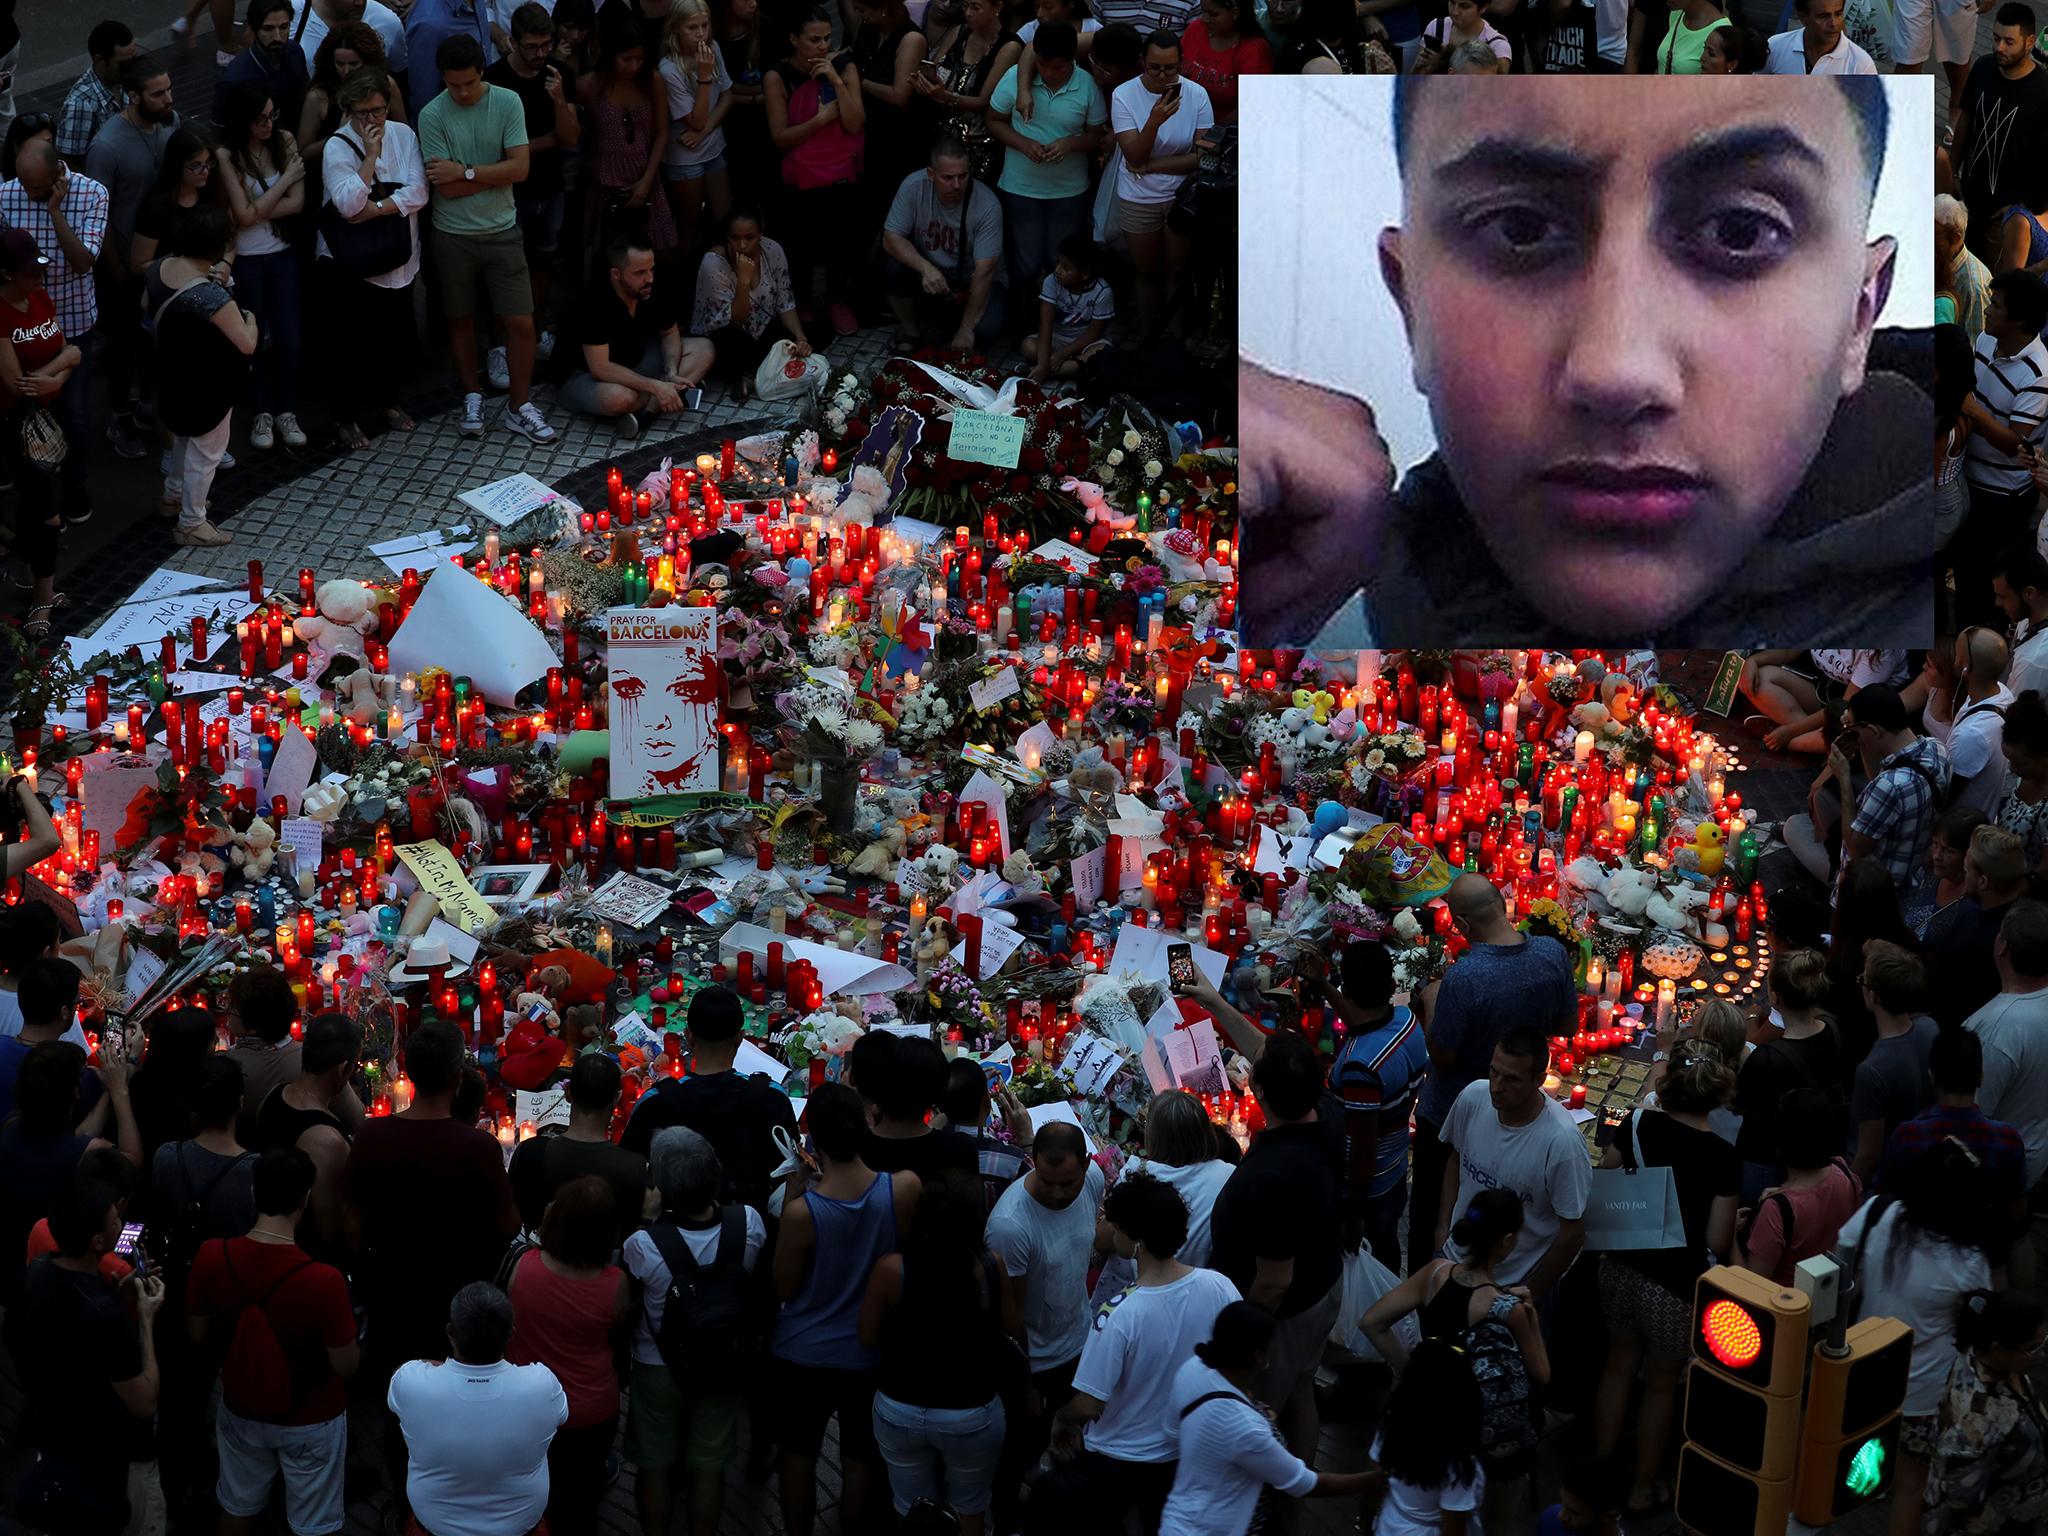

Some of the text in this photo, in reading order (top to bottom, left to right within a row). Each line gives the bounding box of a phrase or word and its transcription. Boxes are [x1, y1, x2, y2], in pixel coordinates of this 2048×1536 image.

[148, 601, 184, 626] PAZ
[610, 615, 656, 625] PRAY FOR
[610, 624, 709, 640] BARCELONA
[1604, 1200, 1648, 1210] VANITY FAIR
